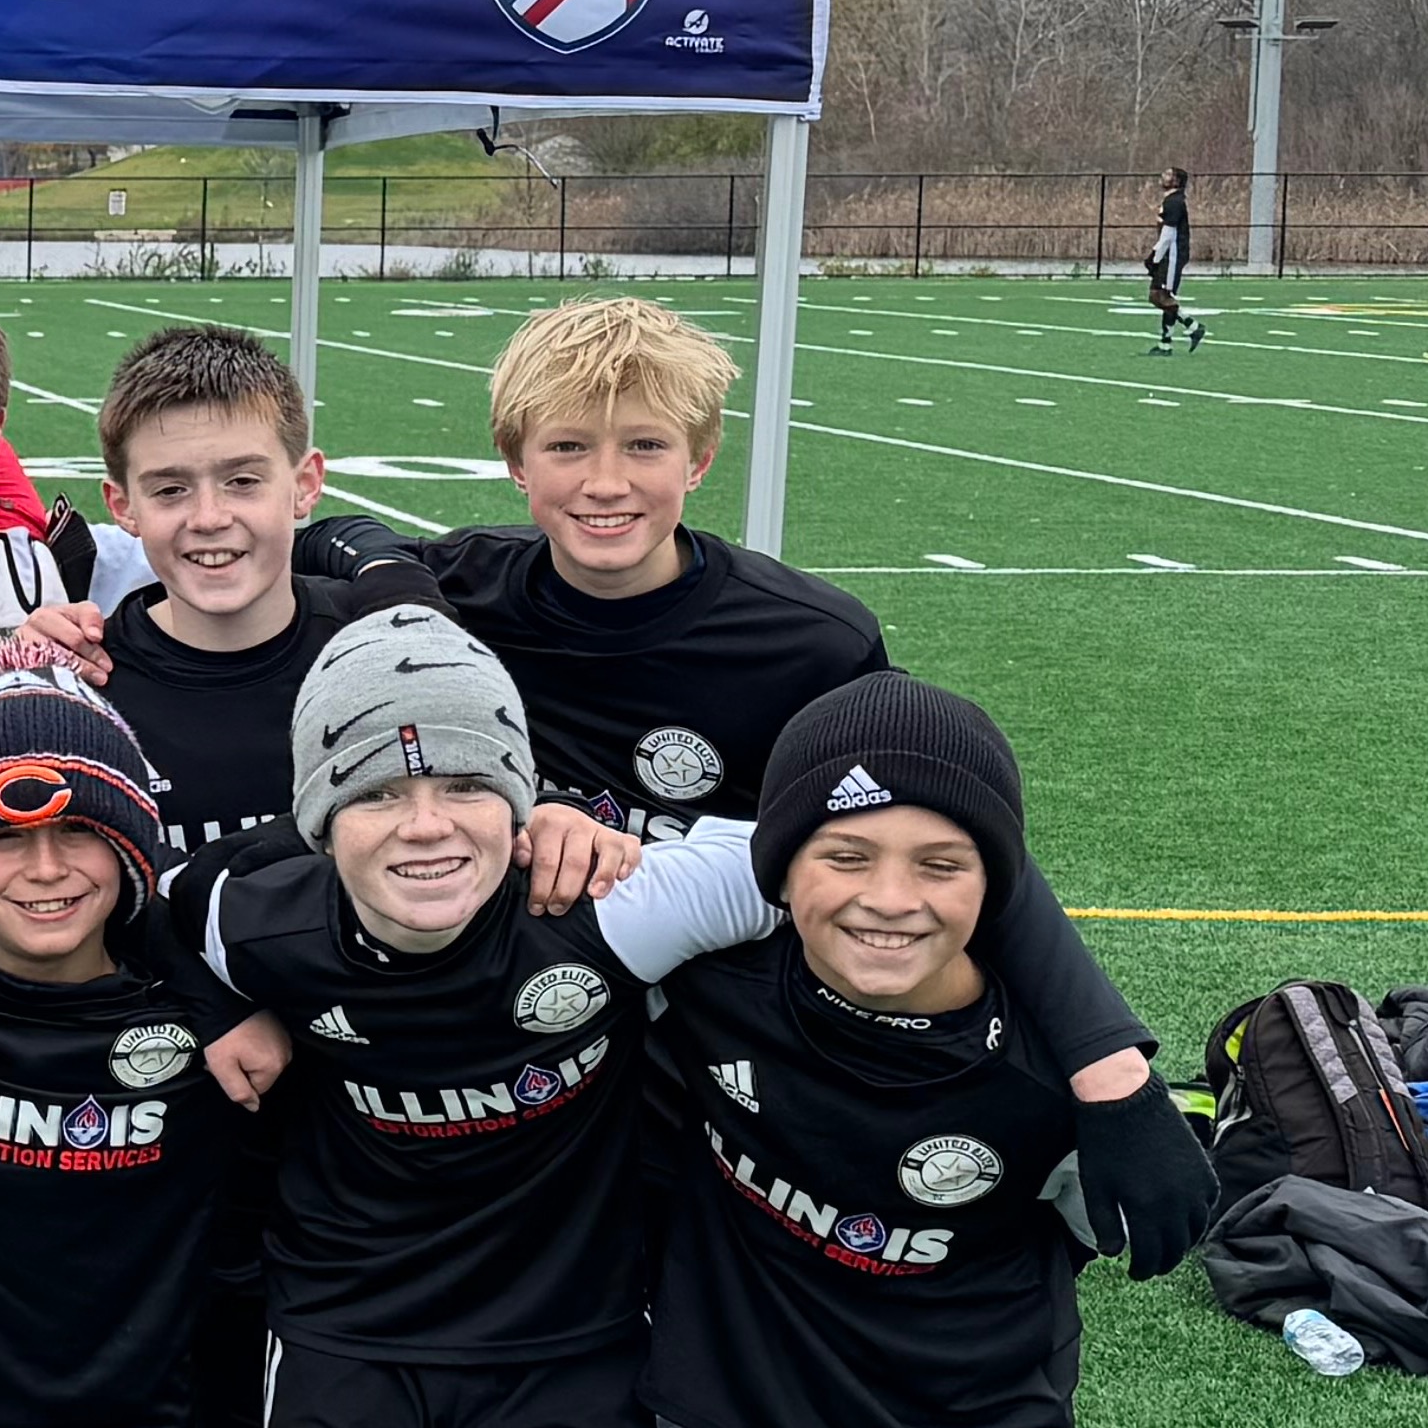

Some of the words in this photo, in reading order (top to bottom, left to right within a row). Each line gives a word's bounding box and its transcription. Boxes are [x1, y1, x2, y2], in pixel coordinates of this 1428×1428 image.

[647, 731, 695, 749] UNITED
[827, 788, 893, 812] adidas
[520, 972, 558, 1010] UNITED
[560, 969, 594, 987] ELITE
[816, 987, 873, 1020] NIKE
[874, 1016, 932, 1030] PRO
[58, 1143, 163, 1171] SERVICES
[918, 1138, 971, 1156] UNITED
